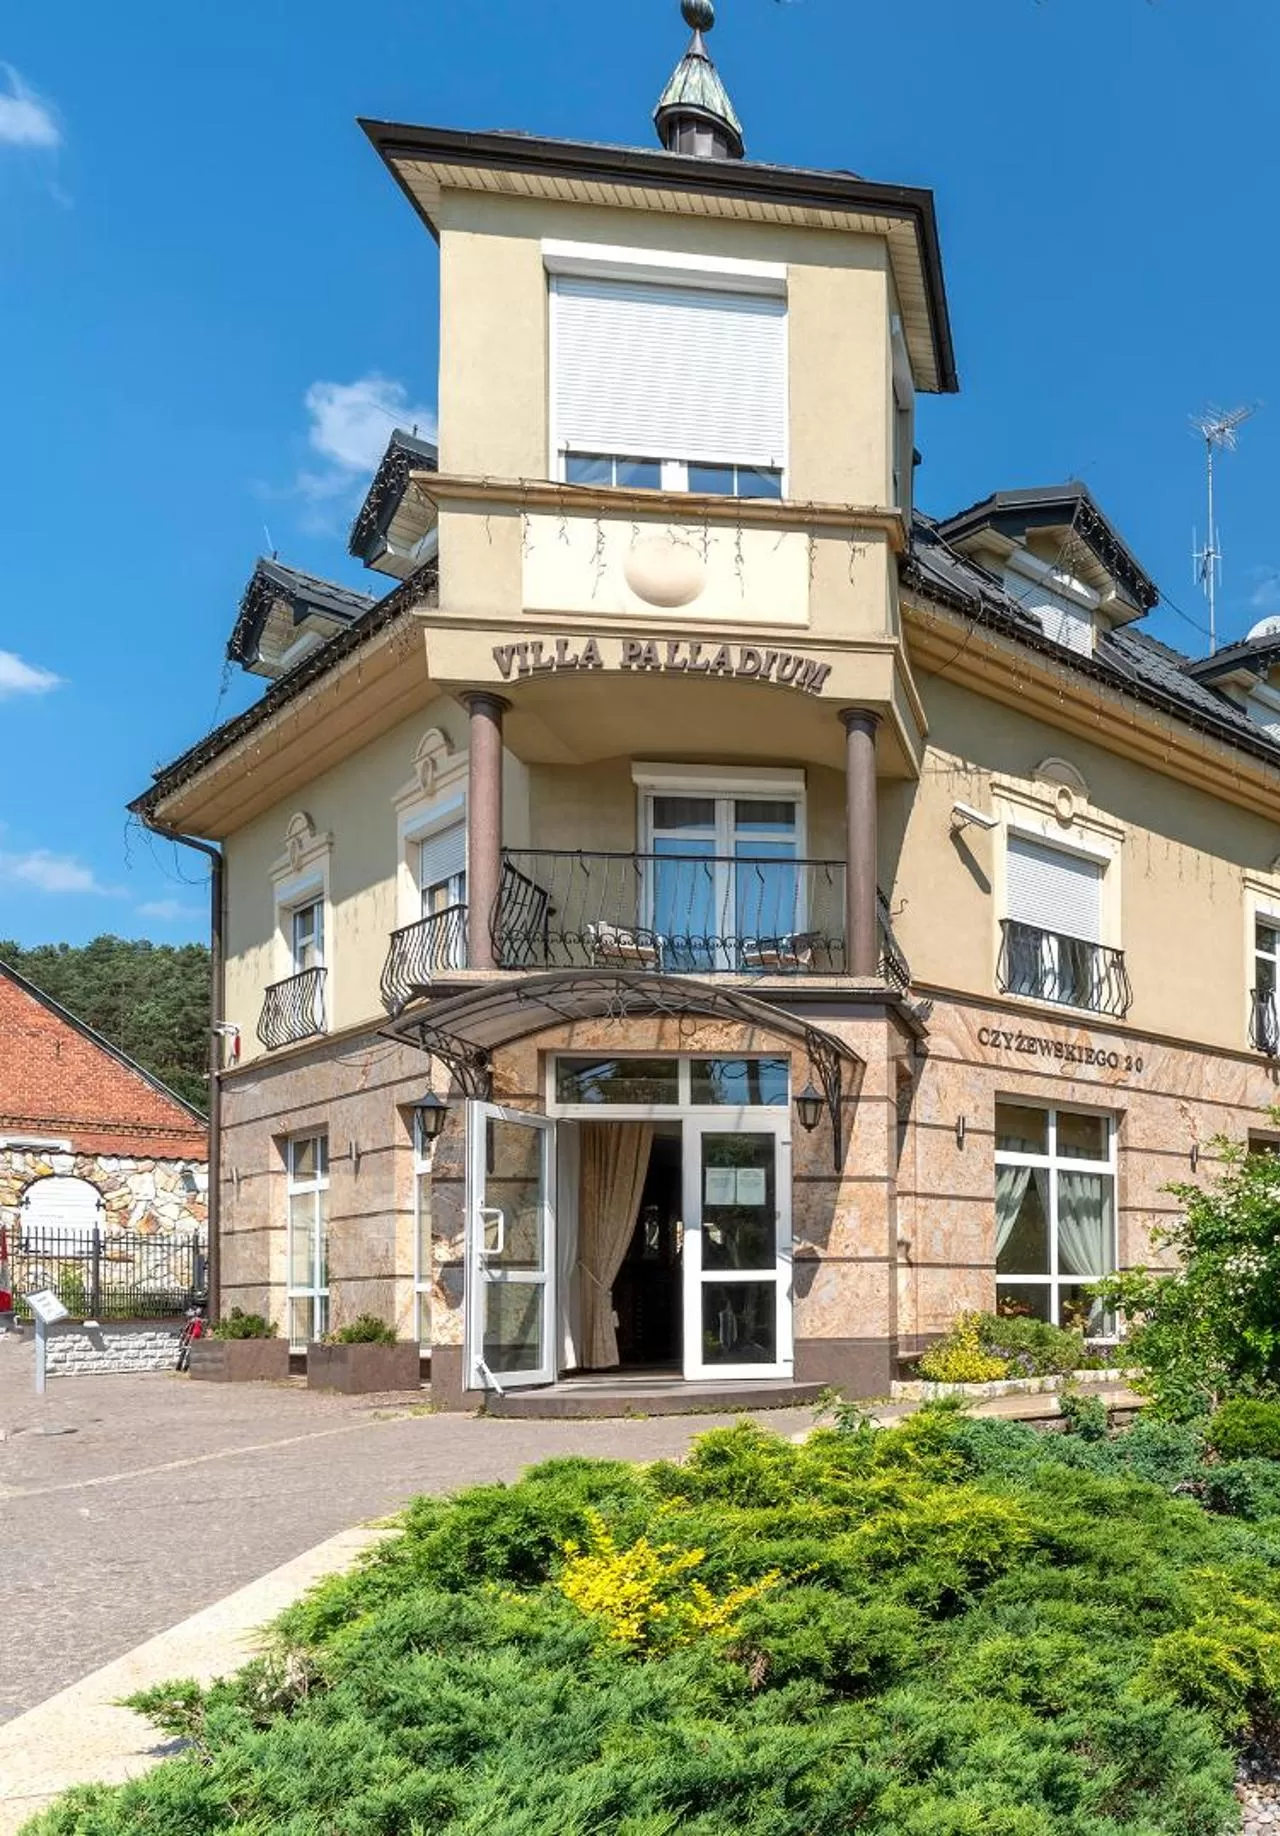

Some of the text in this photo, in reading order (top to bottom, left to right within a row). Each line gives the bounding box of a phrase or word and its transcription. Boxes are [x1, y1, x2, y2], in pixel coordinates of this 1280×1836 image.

[492, 638, 832, 695] VILLA PALLADIUM
[977, 1028, 1144, 1074] CZYŻEWSKIEGO 20
